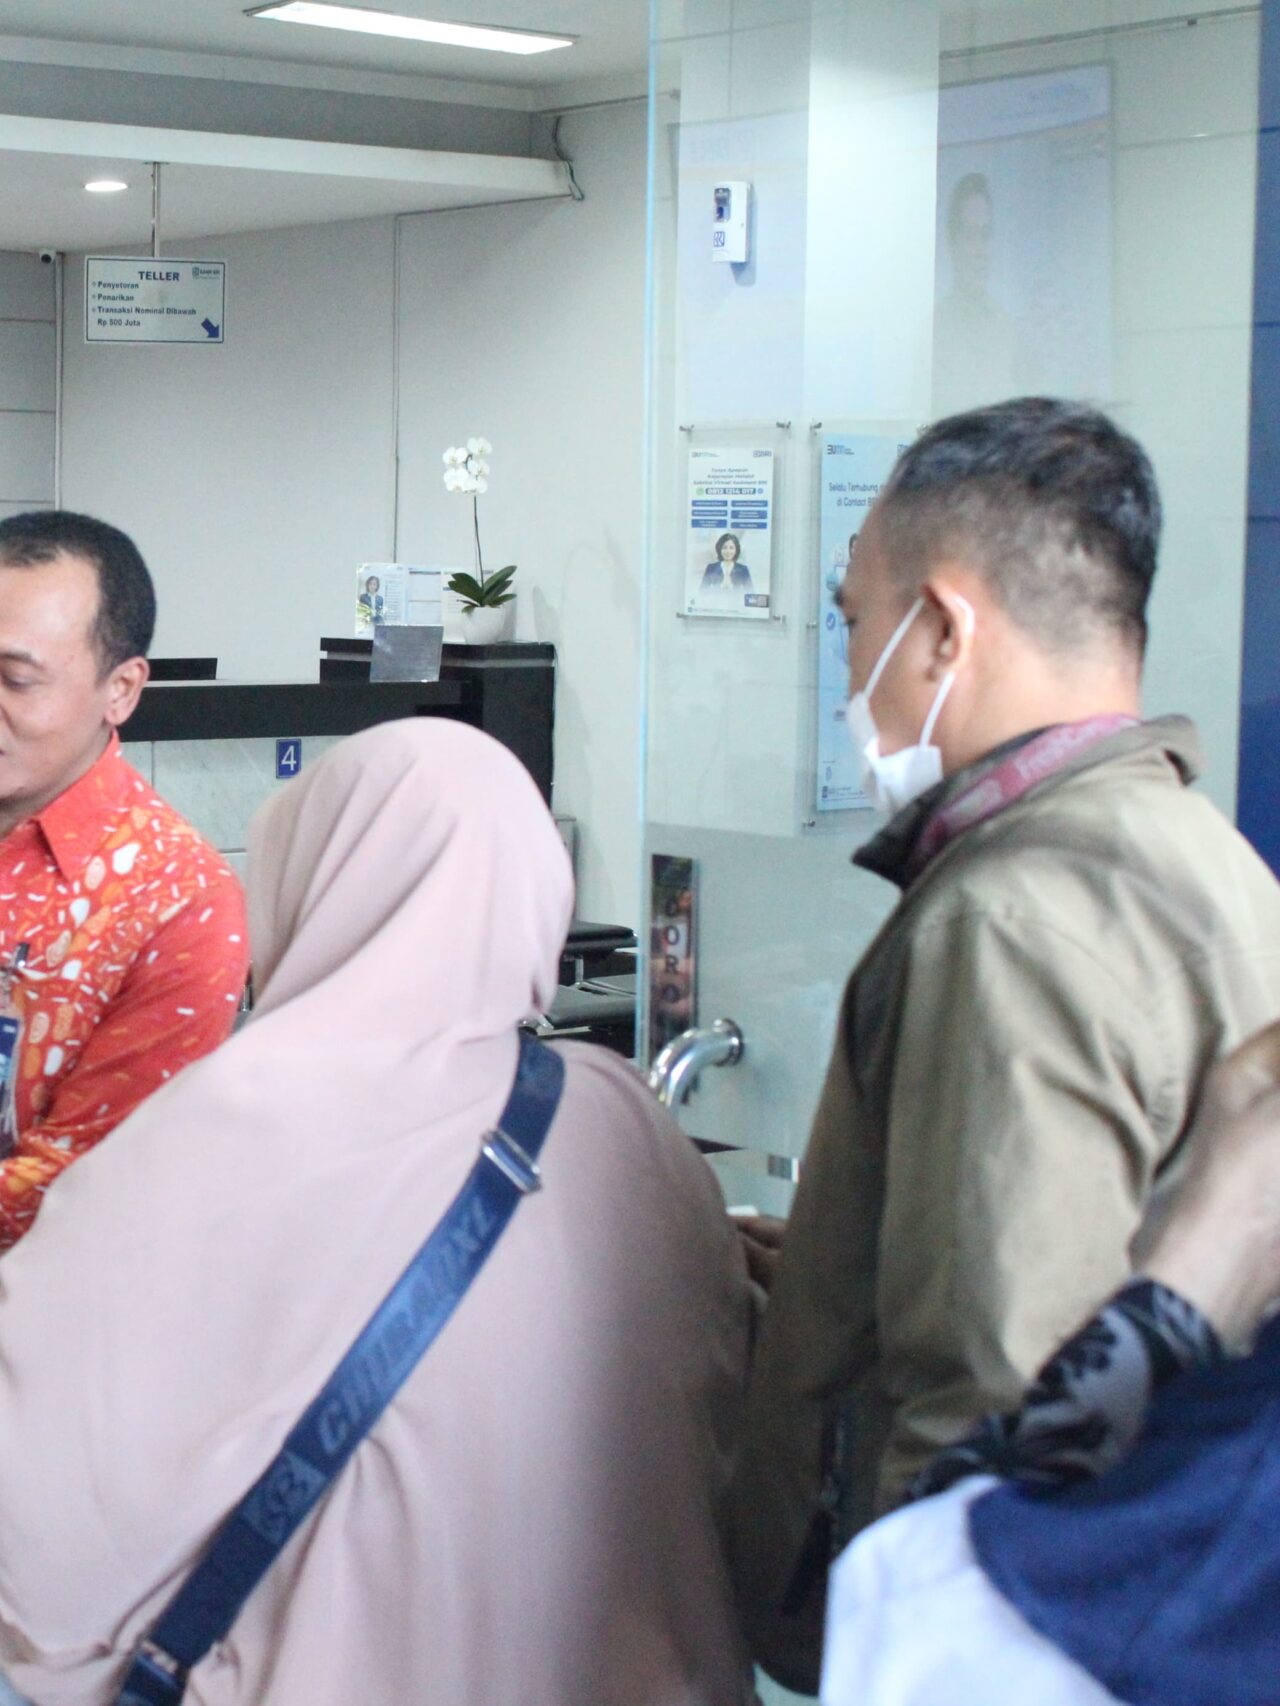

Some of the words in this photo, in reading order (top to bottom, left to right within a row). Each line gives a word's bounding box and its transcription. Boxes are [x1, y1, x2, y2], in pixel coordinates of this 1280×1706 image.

[138, 271, 180, 281] TELLER
[97, 281, 139, 290] Penyetoran
[97, 306, 133, 314] Transaksi
[135, 307, 165, 315] Nominal
[166, 307, 196, 315] Dibawah
[97, 319, 107, 327] Rp
[828, 482, 847, 492] Selalu
[848, 482, 878, 493] Terhubung
[843, 497, 866, 507] Contact
[281, 745, 297, 771] 4
